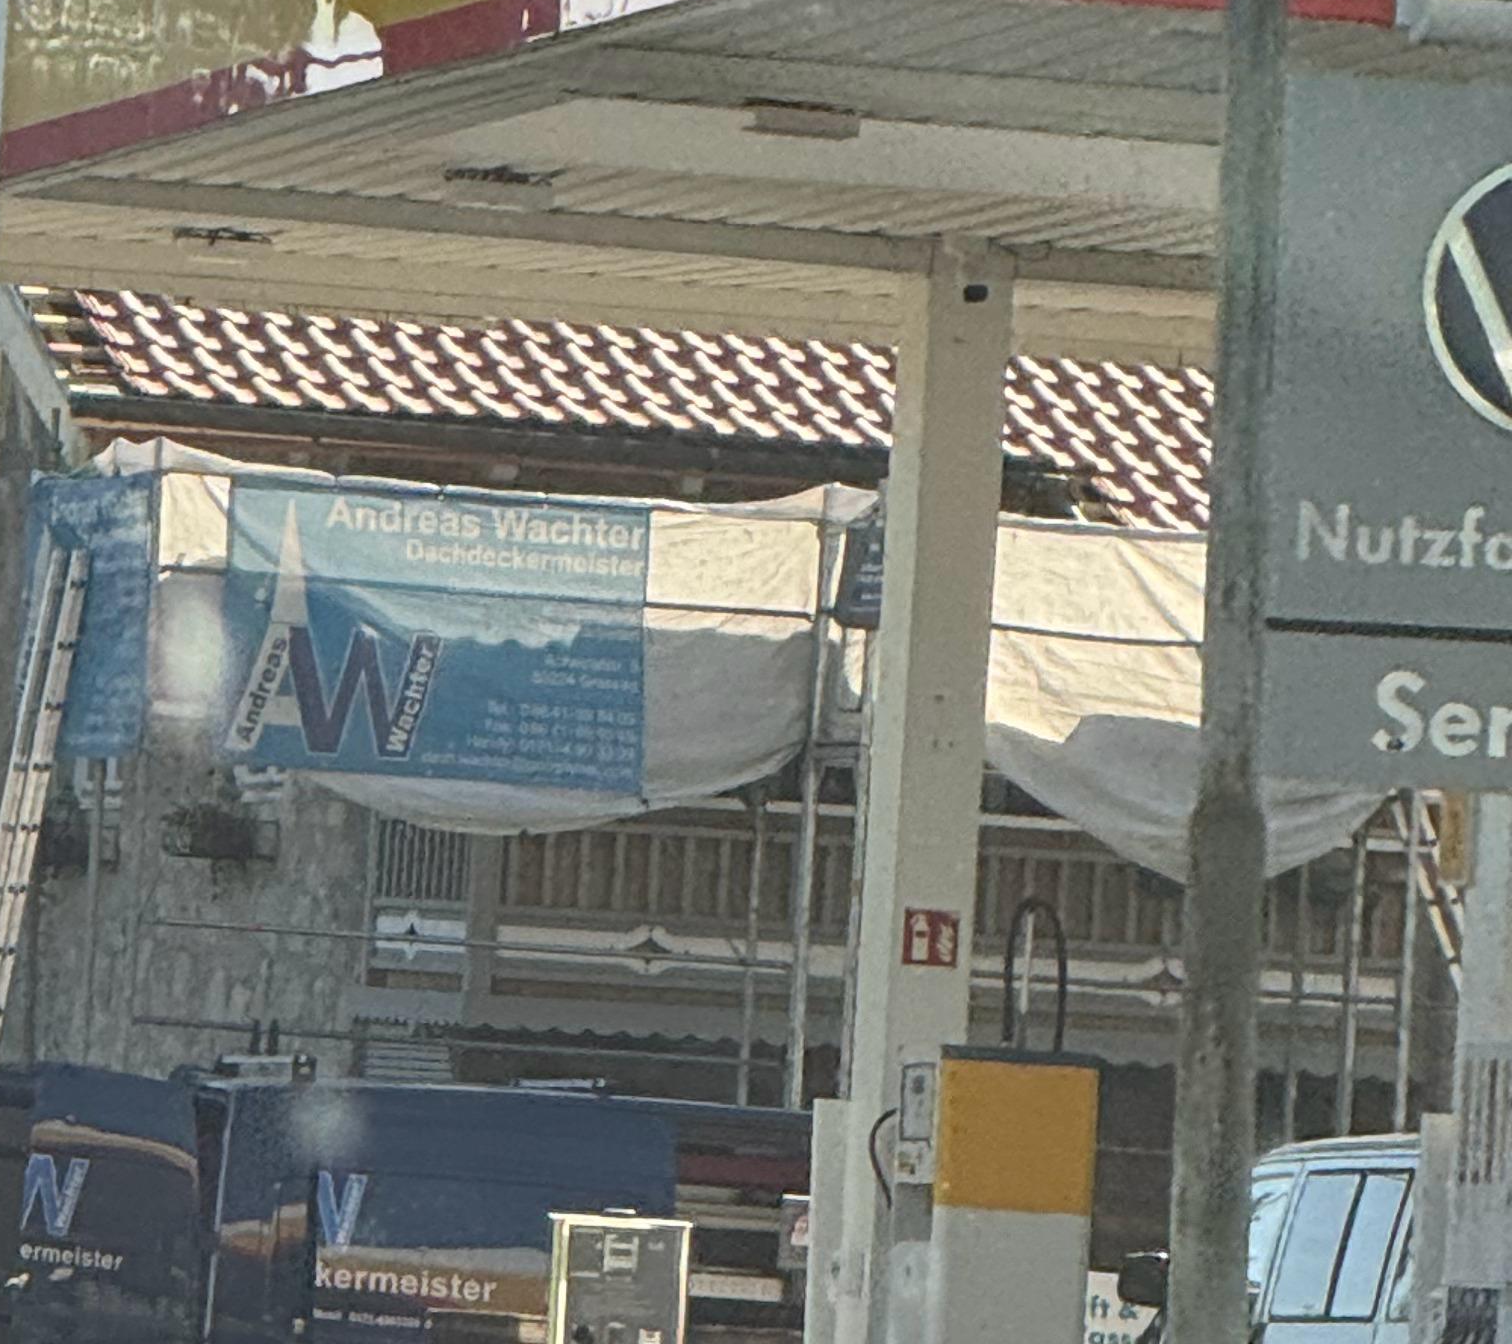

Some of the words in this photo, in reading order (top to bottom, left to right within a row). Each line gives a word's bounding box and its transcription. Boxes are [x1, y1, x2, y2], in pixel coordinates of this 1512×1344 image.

[326, 496, 481, 538] Andreas
[492, 509, 647, 551] Wachter
[406, 539, 646, 577] Dachdeckermeister
[234, 636, 288, 744] Andreas
[388, 643, 437, 753] Wachter
